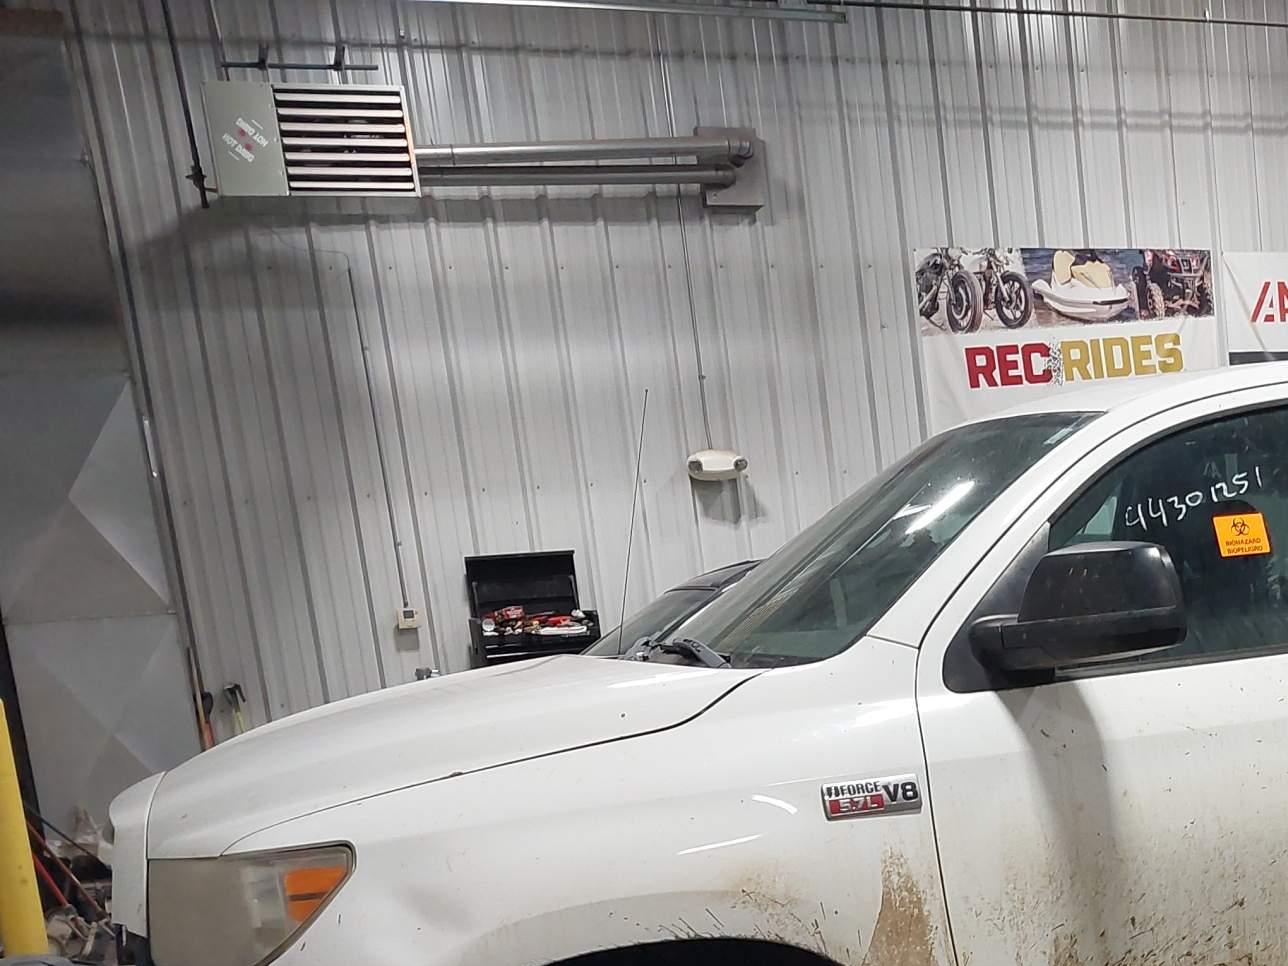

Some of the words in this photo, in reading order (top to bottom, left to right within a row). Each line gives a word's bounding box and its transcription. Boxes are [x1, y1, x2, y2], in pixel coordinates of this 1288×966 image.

[964, 342, 1054, 389] REC
[1060, 332, 1184, 382] RIDES
[882, 781, 918, 802] V8
[839, 796, 878, 811] 5.7L
